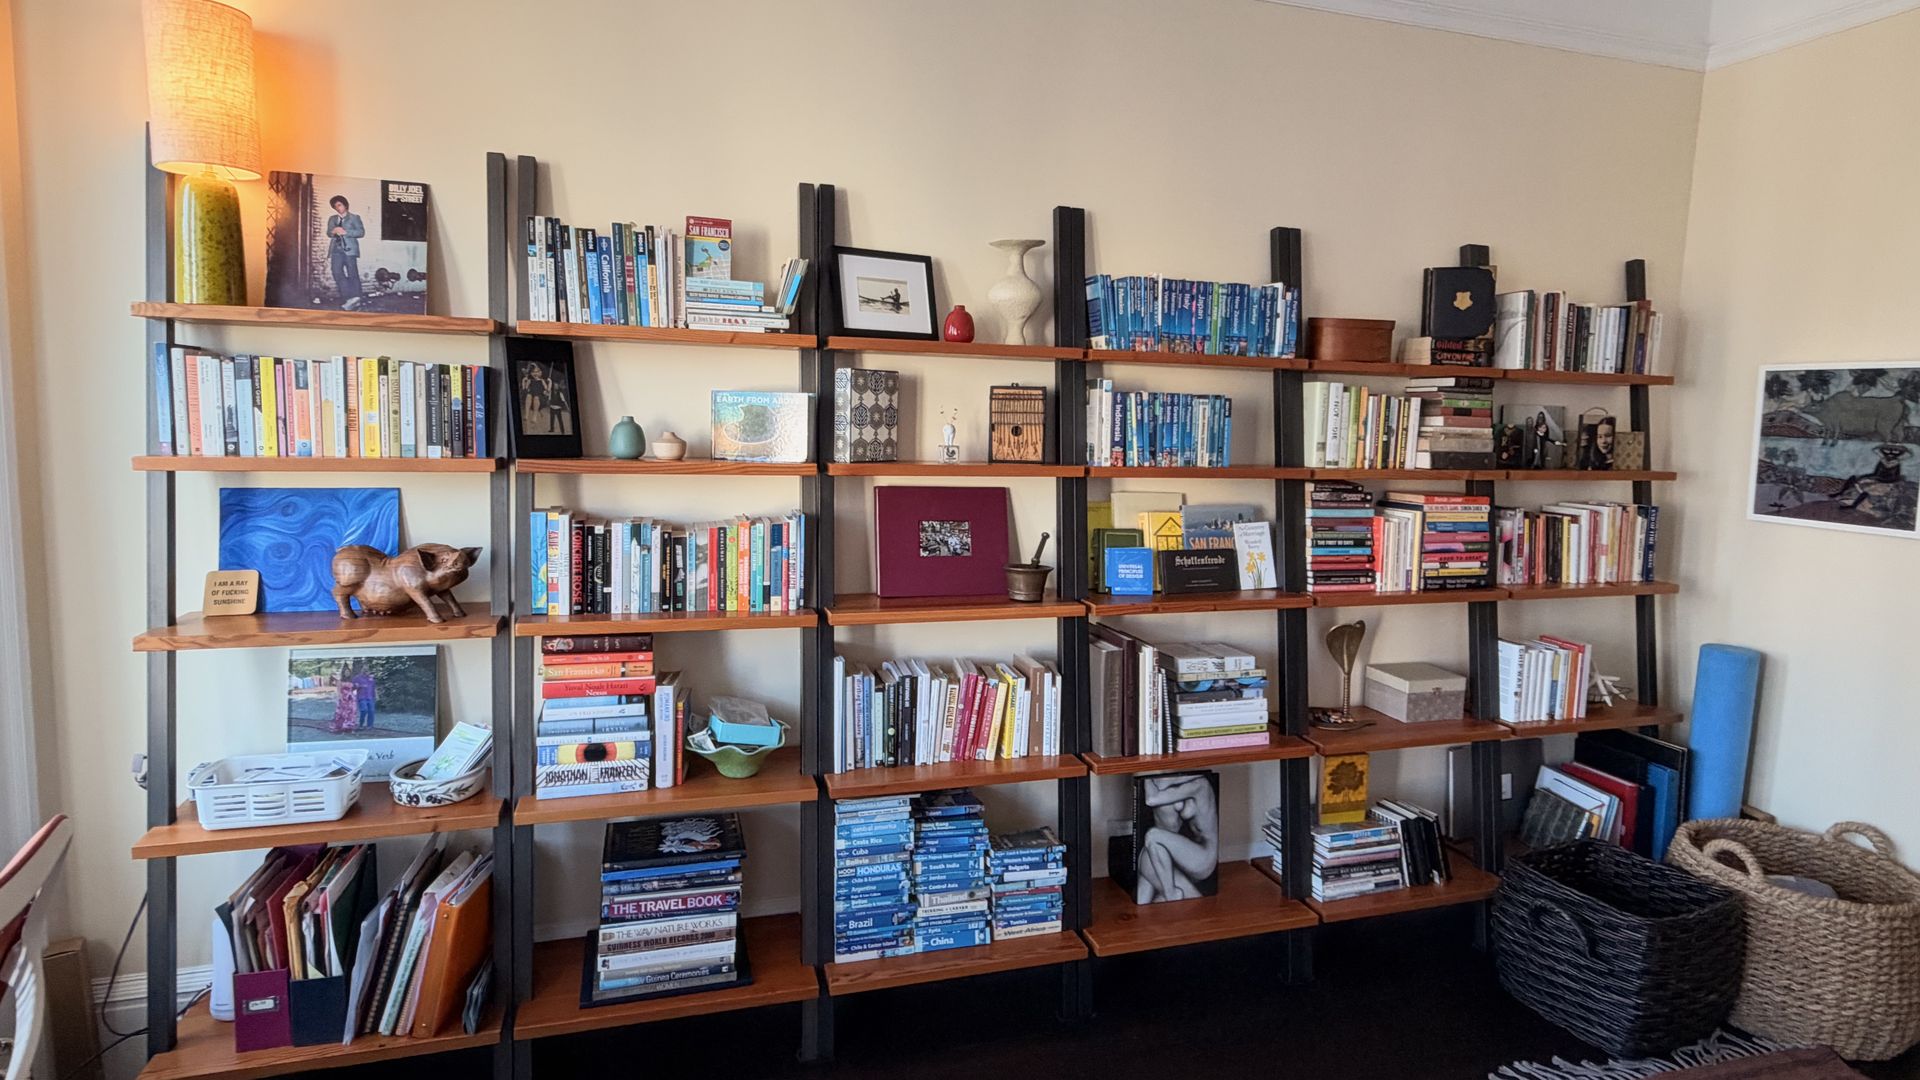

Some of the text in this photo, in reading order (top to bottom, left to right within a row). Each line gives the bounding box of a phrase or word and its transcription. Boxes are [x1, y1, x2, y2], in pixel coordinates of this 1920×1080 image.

[388, 184, 422, 194] BILLY JOEL
[689, 225, 700, 235] SAN
[601, 254, 611, 293] California
[349, 408, 357, 432] DETROIT
[1114, 404, 1122, 441] Indonesia
[1189, 537, 1206, 549] SAN
[572, 530, 583, 604] CONCRETE ROSE
[374, 749, 395, 760] Verb
[545, 765, 637, 783] JONATHAN FRANZEN
[857, 863, 902, 876] HONDURAS
[612, 894, 722, 914] THE TRAVEL BOOK
[931, 895, 967, 905] Thailand
[616, 918, 723, 939] THE WAY NATURE WORKS
[849, 918, 873, 929] Brazil
[607, 941, 641, 951] GUINNESS
[644, 938, 667, 947] WORLD
[669, 933, 699, 943] RECORDS
[930, 937, 954, 946] China
[646, 974, 669, 984] Guinea
[670, 969, 710, 980] Ceremonies
